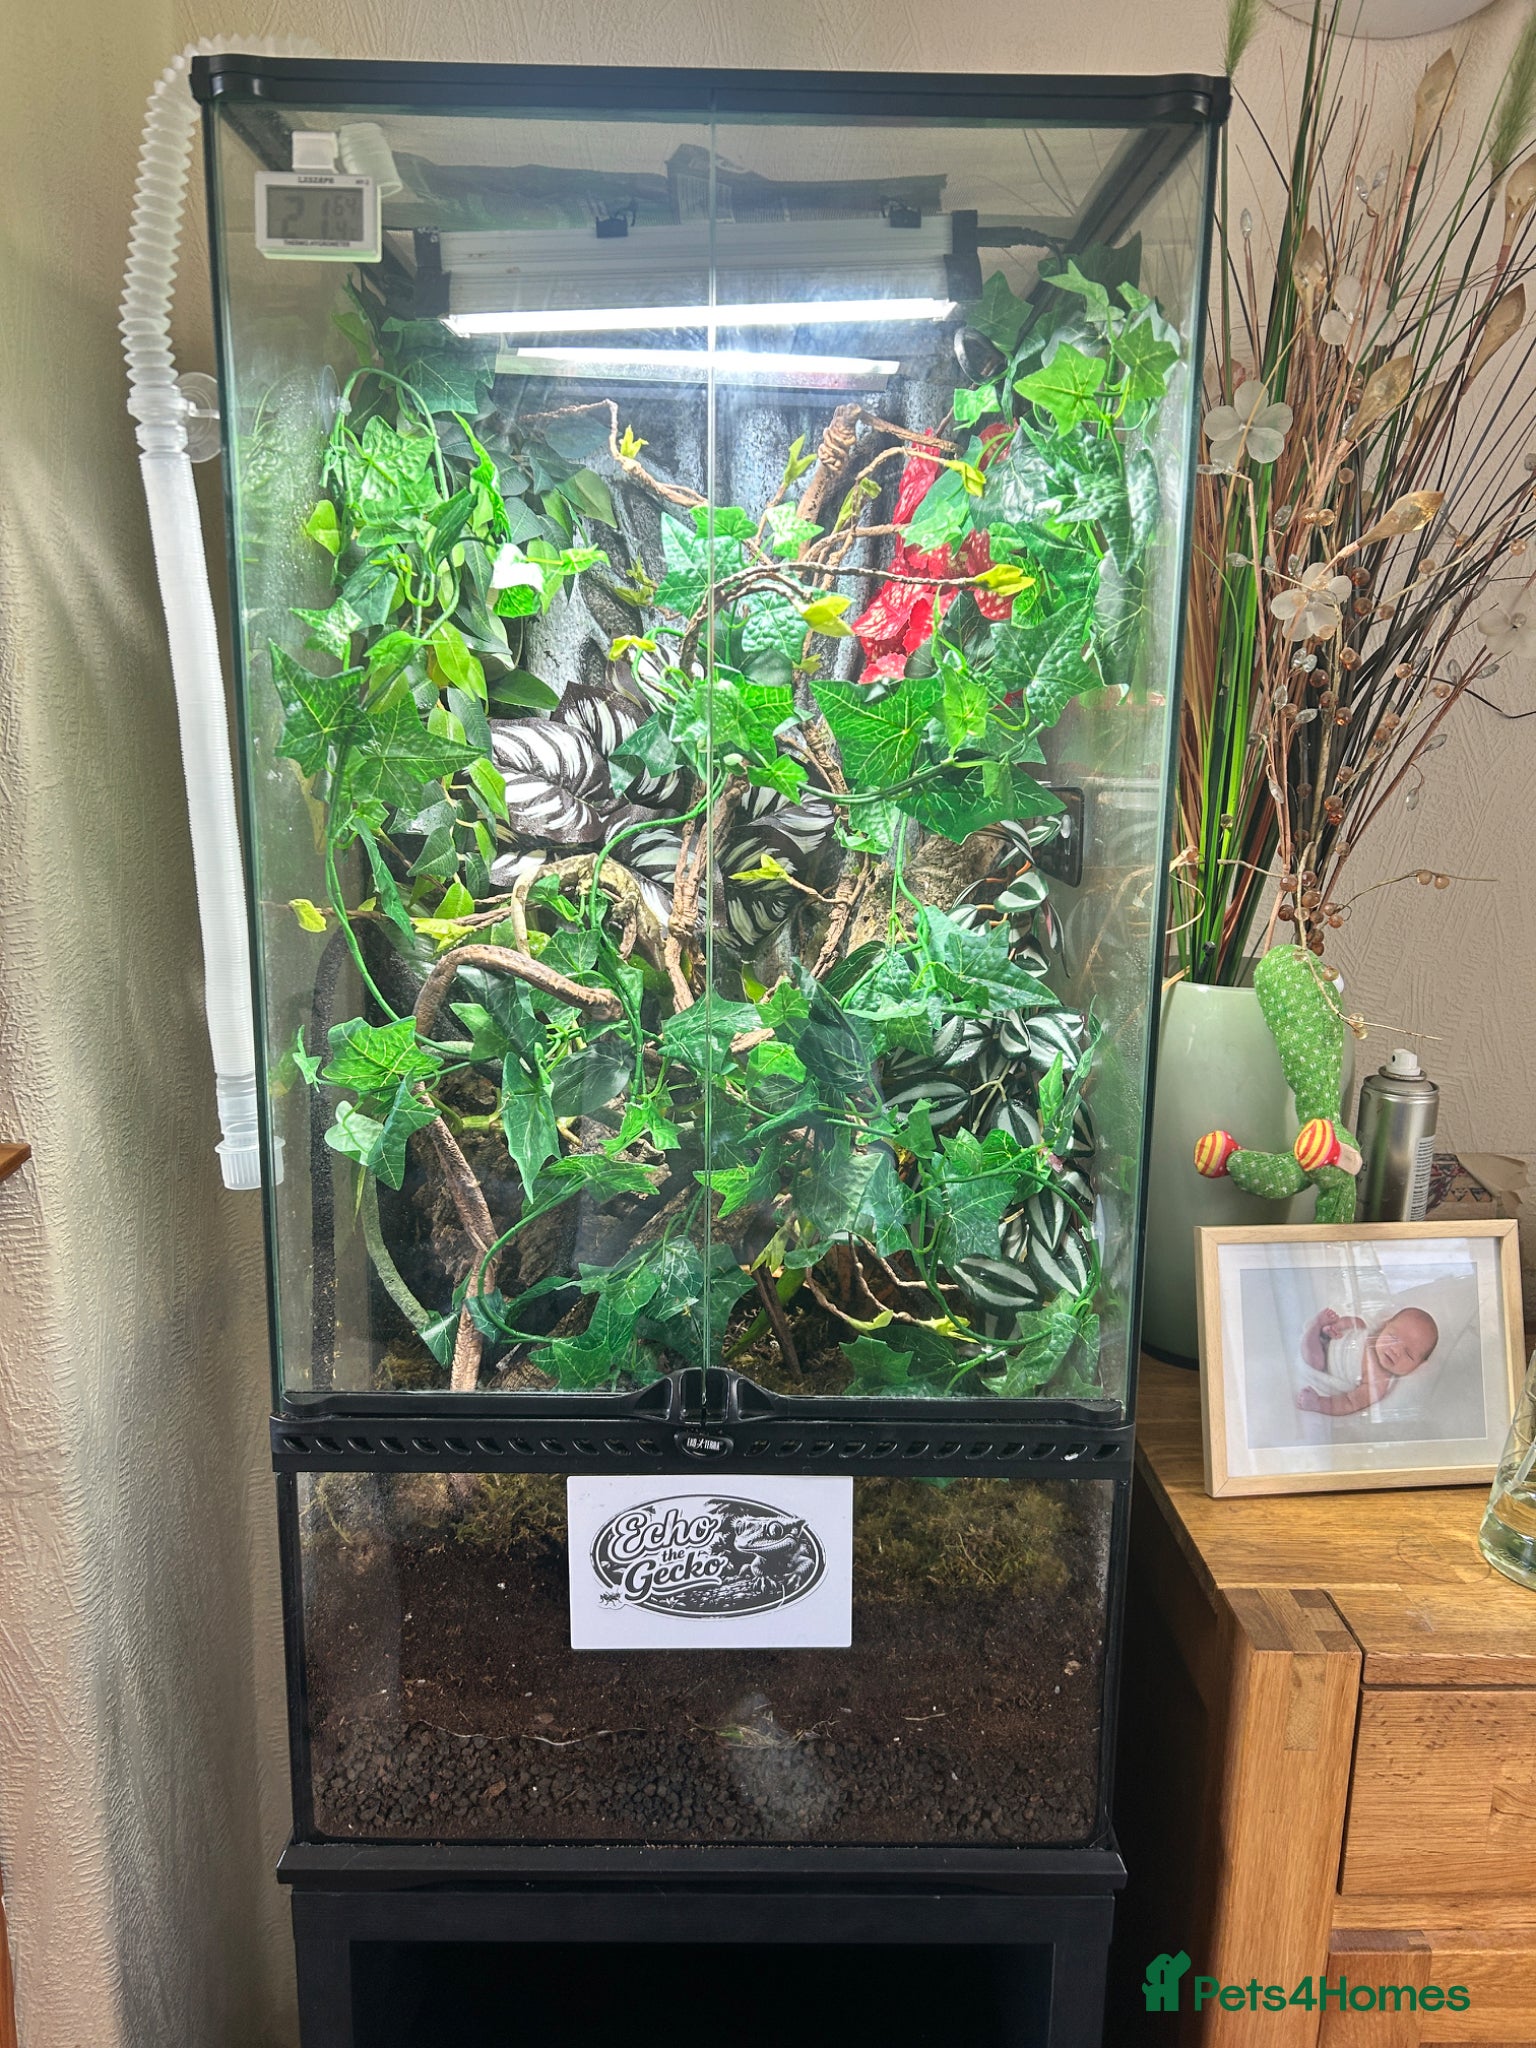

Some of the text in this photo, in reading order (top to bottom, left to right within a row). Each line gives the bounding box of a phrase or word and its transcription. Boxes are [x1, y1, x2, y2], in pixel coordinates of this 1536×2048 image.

[608, 1509, 719, 1563] Echo
[661, 1549, 686, 1563] the
[624, 1553, 726, 1601] Gecko
